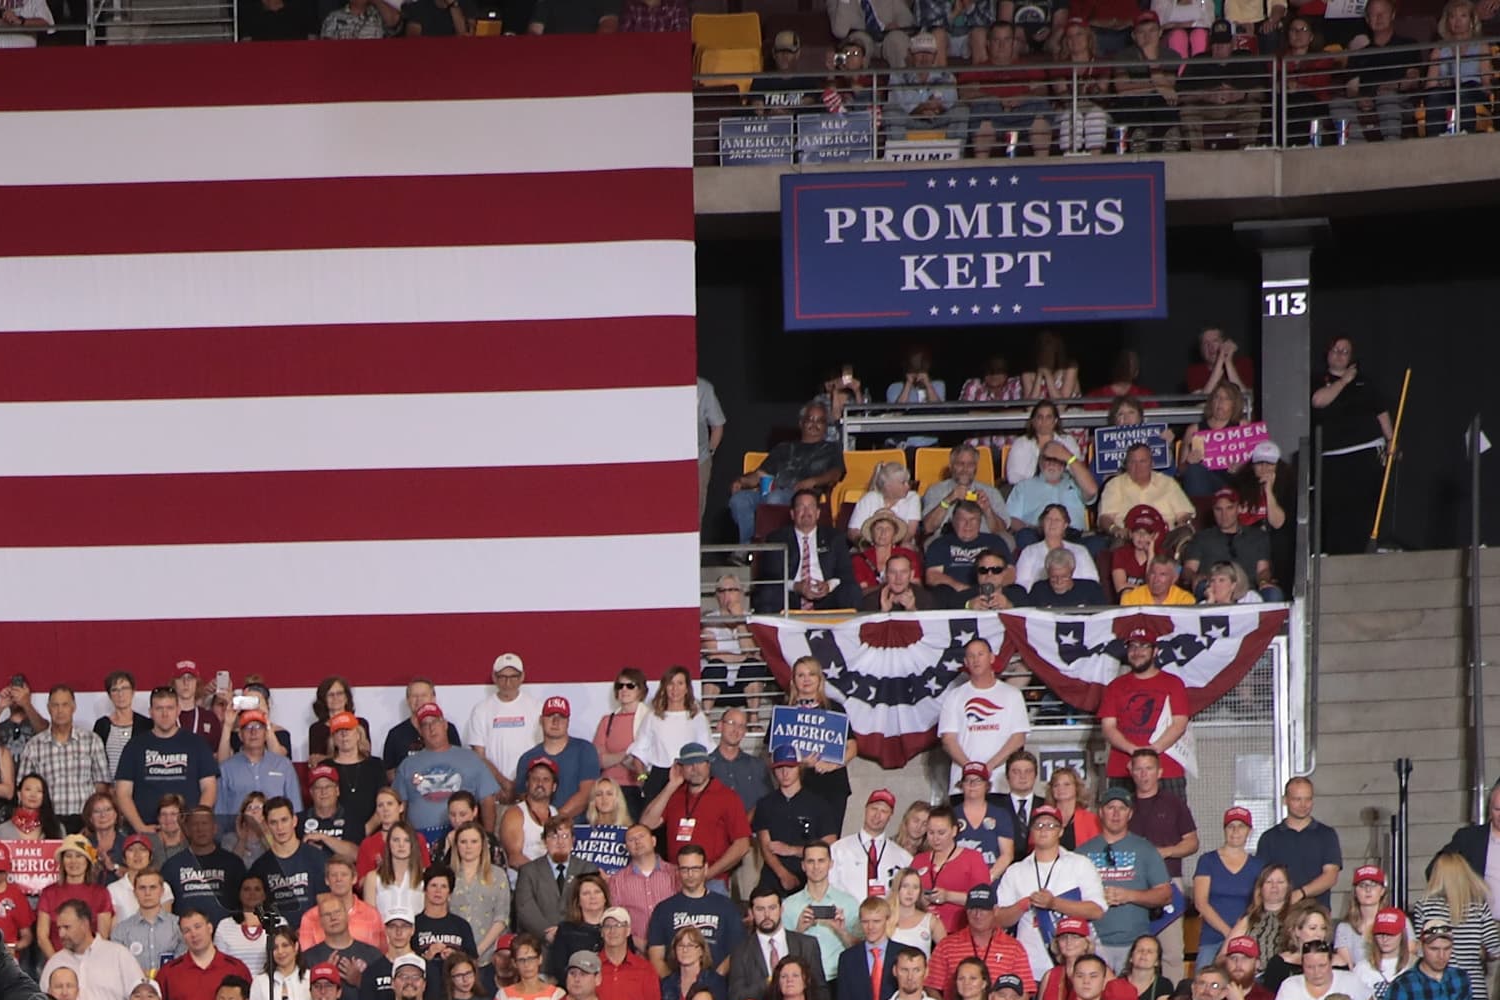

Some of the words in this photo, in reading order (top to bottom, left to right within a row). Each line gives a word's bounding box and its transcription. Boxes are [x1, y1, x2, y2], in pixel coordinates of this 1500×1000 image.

[764, 94, 804, 106] TRUM
[744, 124, 769, 132] MAKE
[821, 120, 848, 129] KEEP
[722, 136, 791, 150] AMERICA
[802, 132, 869, 147] AMERICA
[891, 153, 953, 161] TRUMP
[824, 198, 1124, 244] PROMISES
[900, 250, 1051, 291] KEPT
[1265, 292, 1307, 316] 113
[1104, 428, 1160, 441] PROMISES
[1221, 442, 1246, 453] FOR
[1104, 449, 1161, 462] PROS
[1204, 451, 1253, 467] TRUM
[797, 713, 825, 725] KEEP
[774, 723, 844, 745] AMERICA
[791, 739, 825, 754] GREAT
[146, 753, 188, 764] STAUBER
[149, 767, 183, 775] CONGRESS
[590, 830, 616, 840] MAKE
[15, 848, 42, 857] MAKE
[574, 840, 629, 857] MERIC
[11, 859, 60, 872] ERIC
[594, 853, 628, 867] AGAIN
[7, 873, 31, 884] OUD
[34, 873, 60, 883] AGAI
[180, 870, 224, 882] STAUBER
[674, 914, 719, 926] STAUBER
[418, 934, 462, 946] STAUBER
